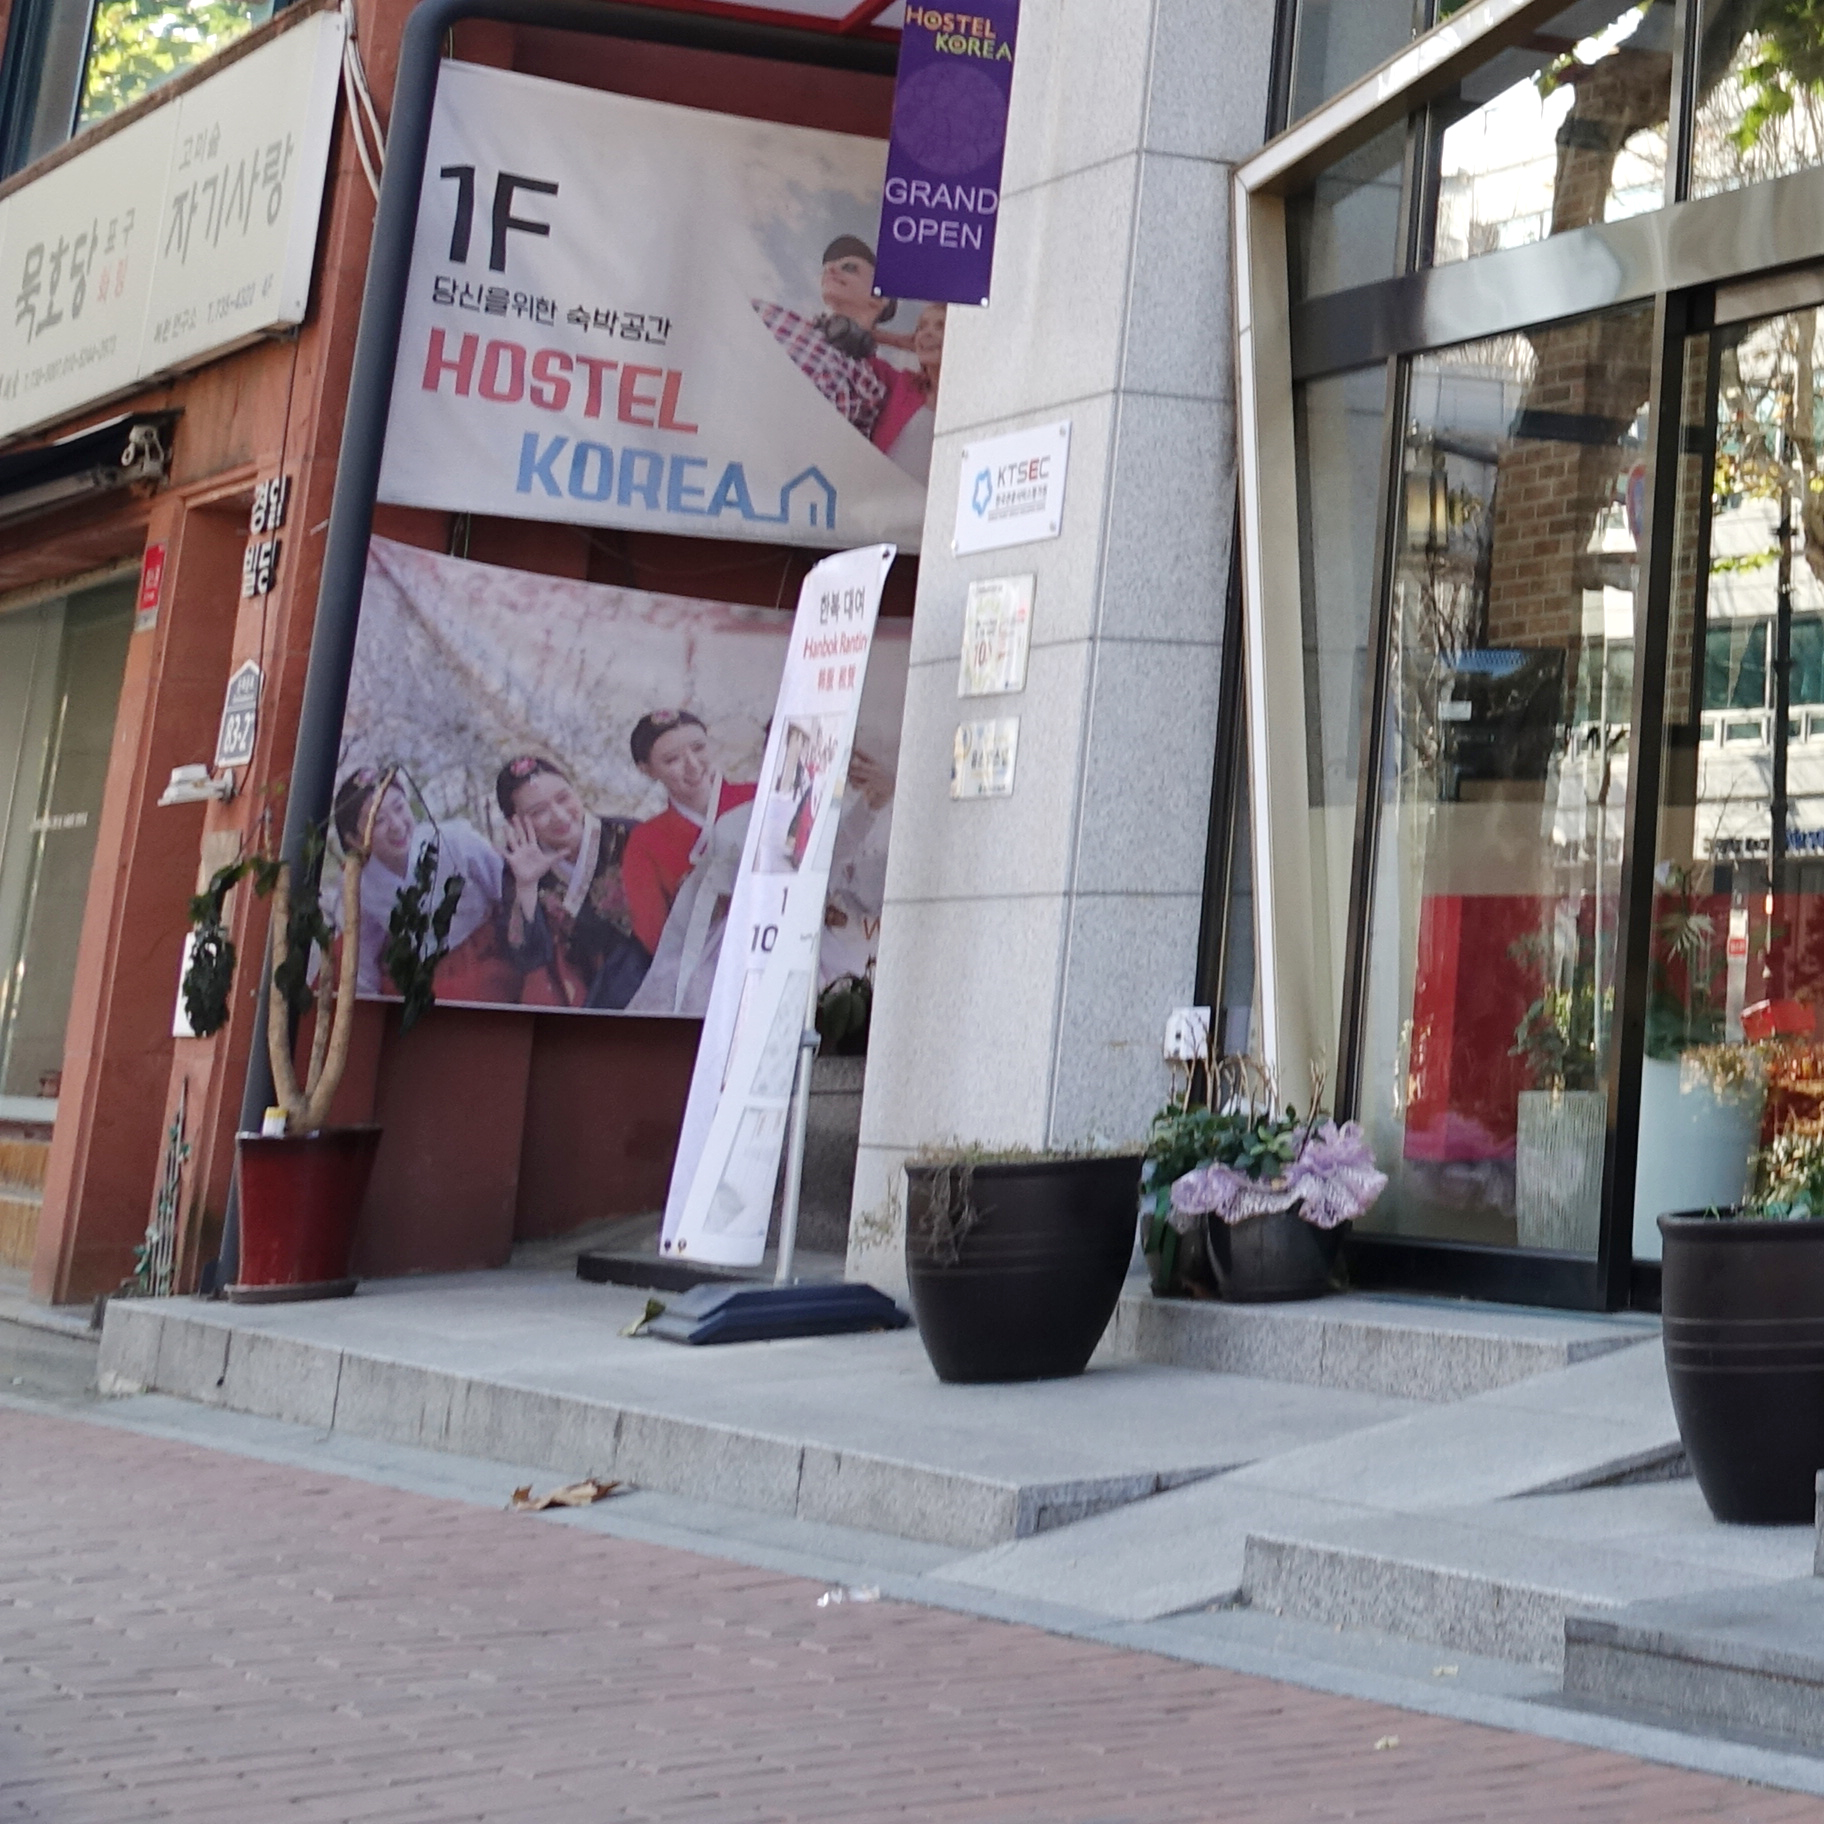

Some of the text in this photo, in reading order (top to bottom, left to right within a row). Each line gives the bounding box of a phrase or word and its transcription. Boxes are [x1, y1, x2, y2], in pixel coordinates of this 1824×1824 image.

[905, 4, 997, 40] HOSTEL
[934, 32, 1013, 63] KOREA
[885, 176, 999, 216] GRAND
[440, 164, 559, 275] 1F
[892, 215, 983, 251] OPEN
[567, 299, 673, 346] 숙박공간
[421, 327, 699, 435] HOSTEL
[516, 431, 757, 519] KOREA
[997, 454, 1051, 489] KTSEC
